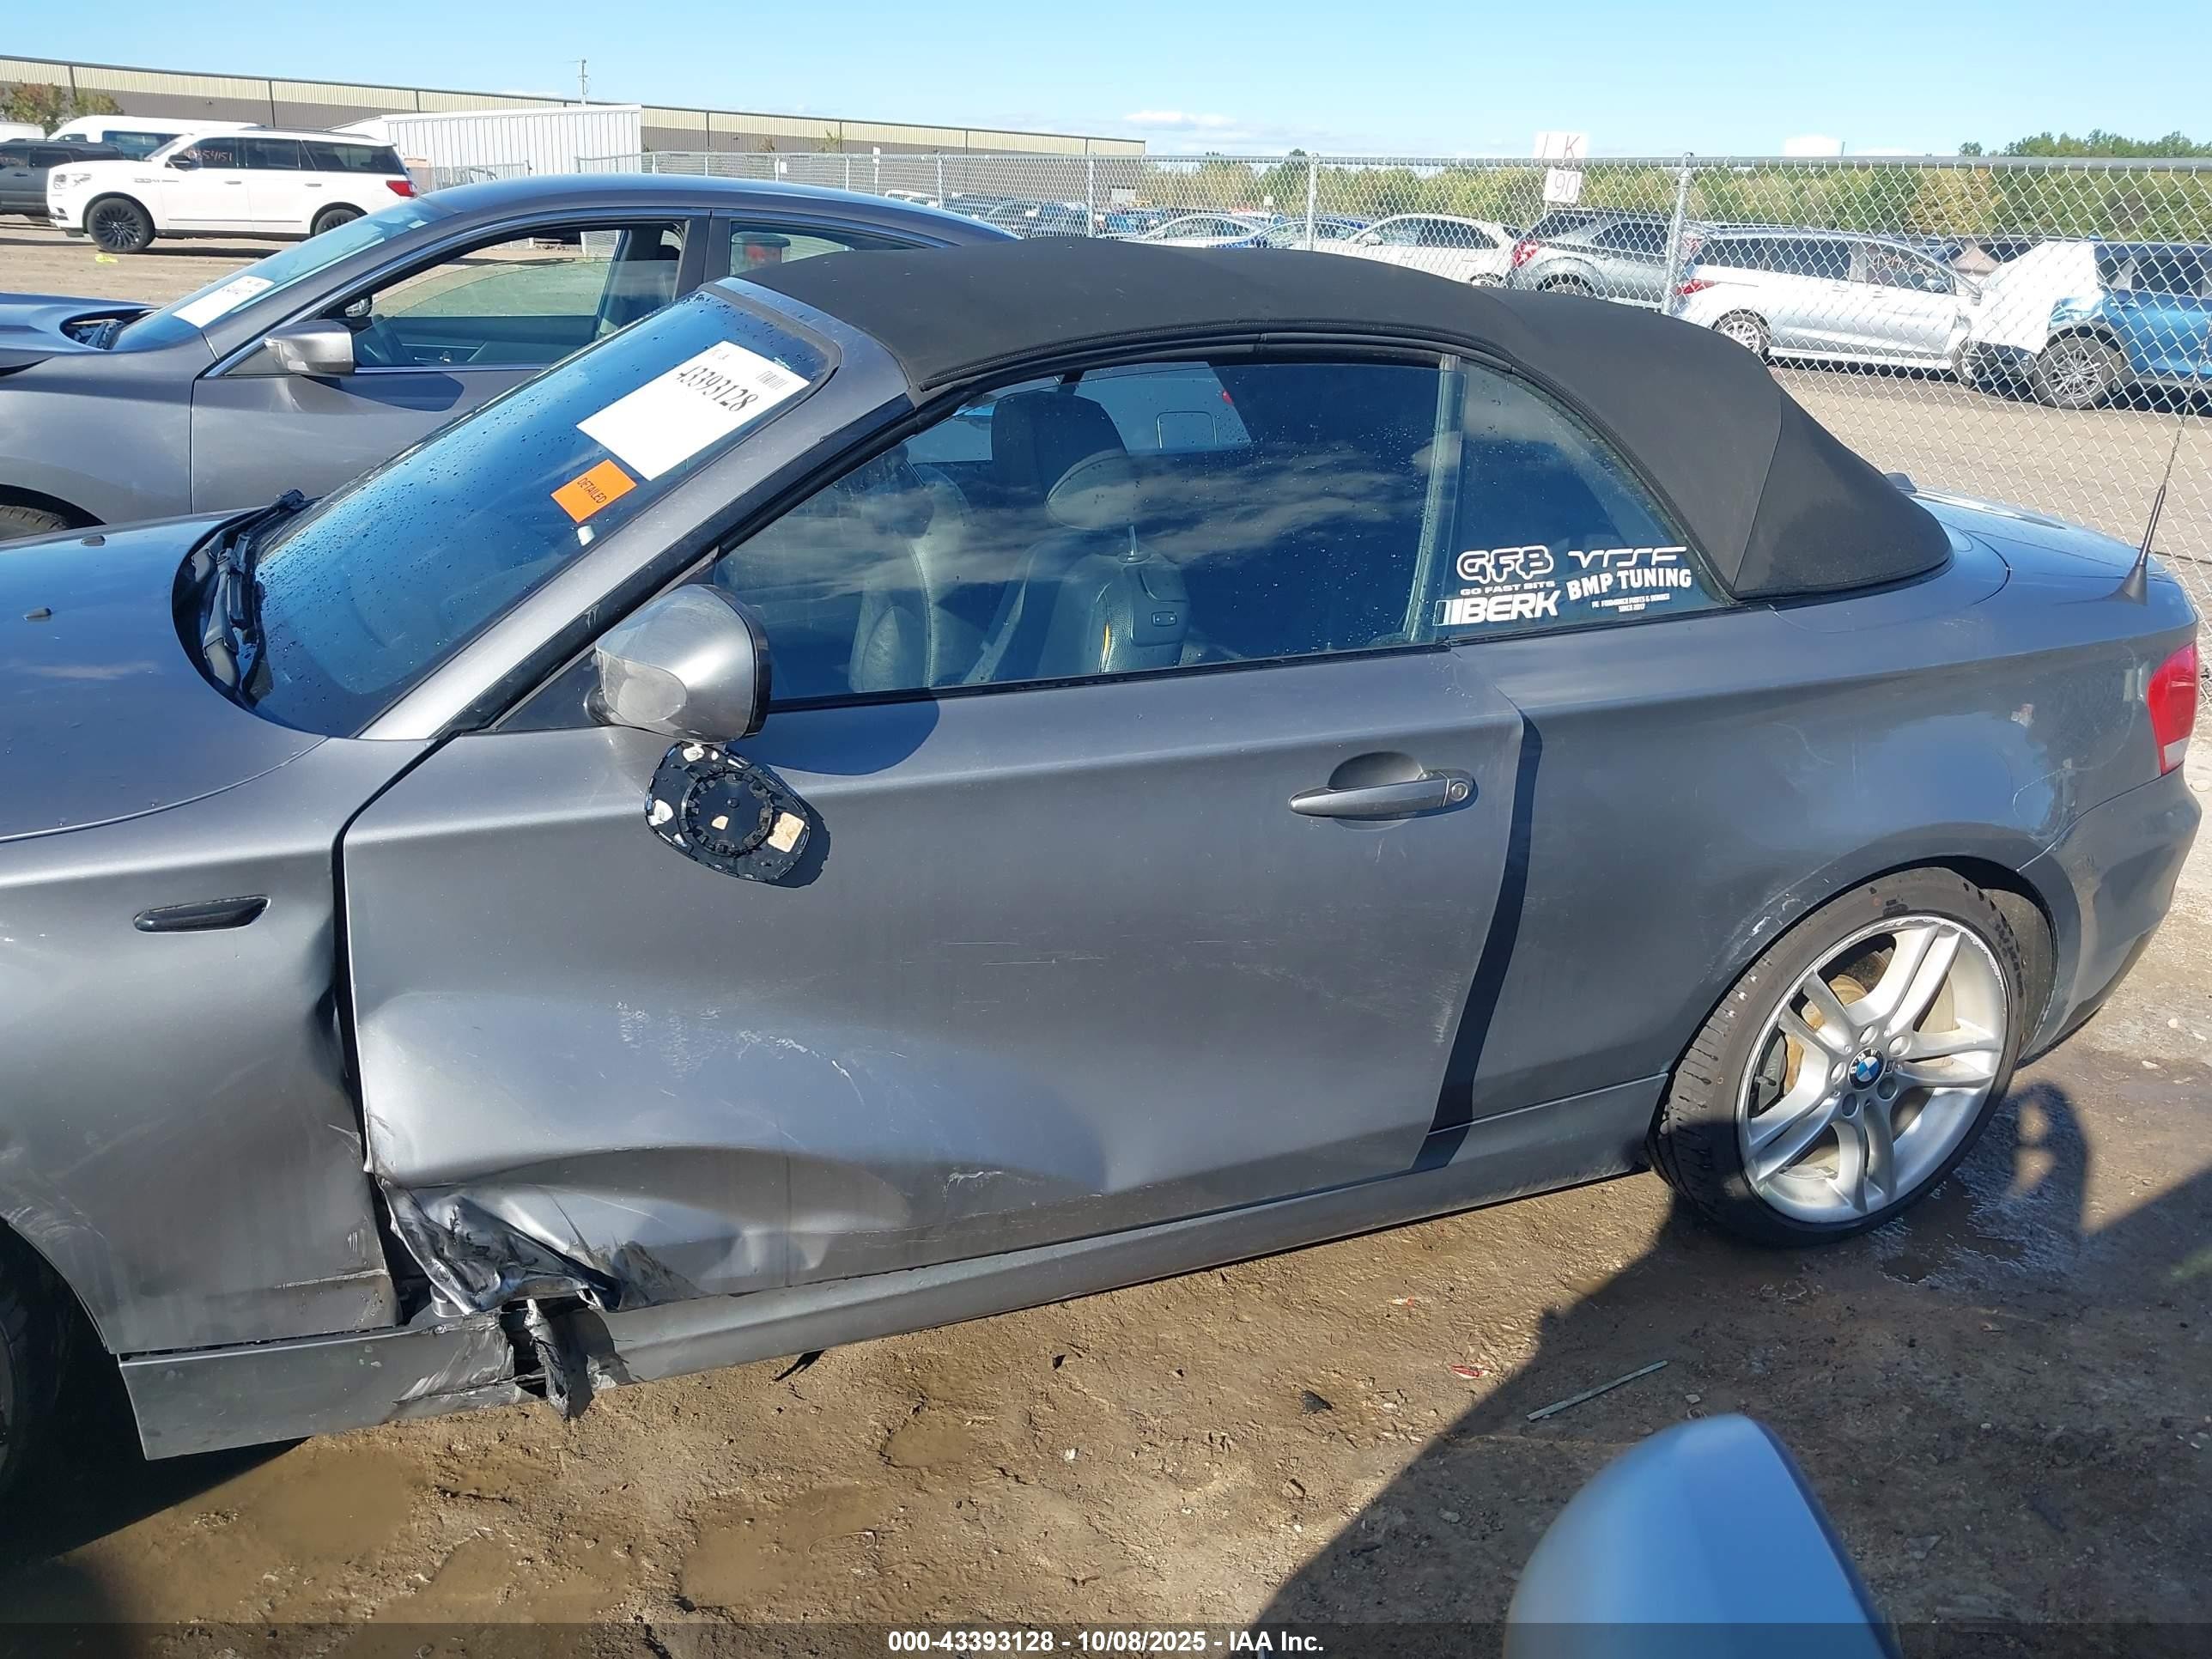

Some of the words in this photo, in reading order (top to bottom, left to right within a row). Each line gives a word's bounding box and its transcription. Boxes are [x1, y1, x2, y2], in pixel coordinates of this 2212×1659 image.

[676, 365, 759, 411] 43393128
[577, 477, 607, 504] DETAILED
[1456, 545, 1554, 584] GFB
[1460, 587, 1482, 596] GO
[1485, 583, 1522, 594] FAST
[1523, 580, 1556, 590] BITS
[1566, 572, 1613, 600] BMP
[1617, 568, 1692, 590] TUNING
